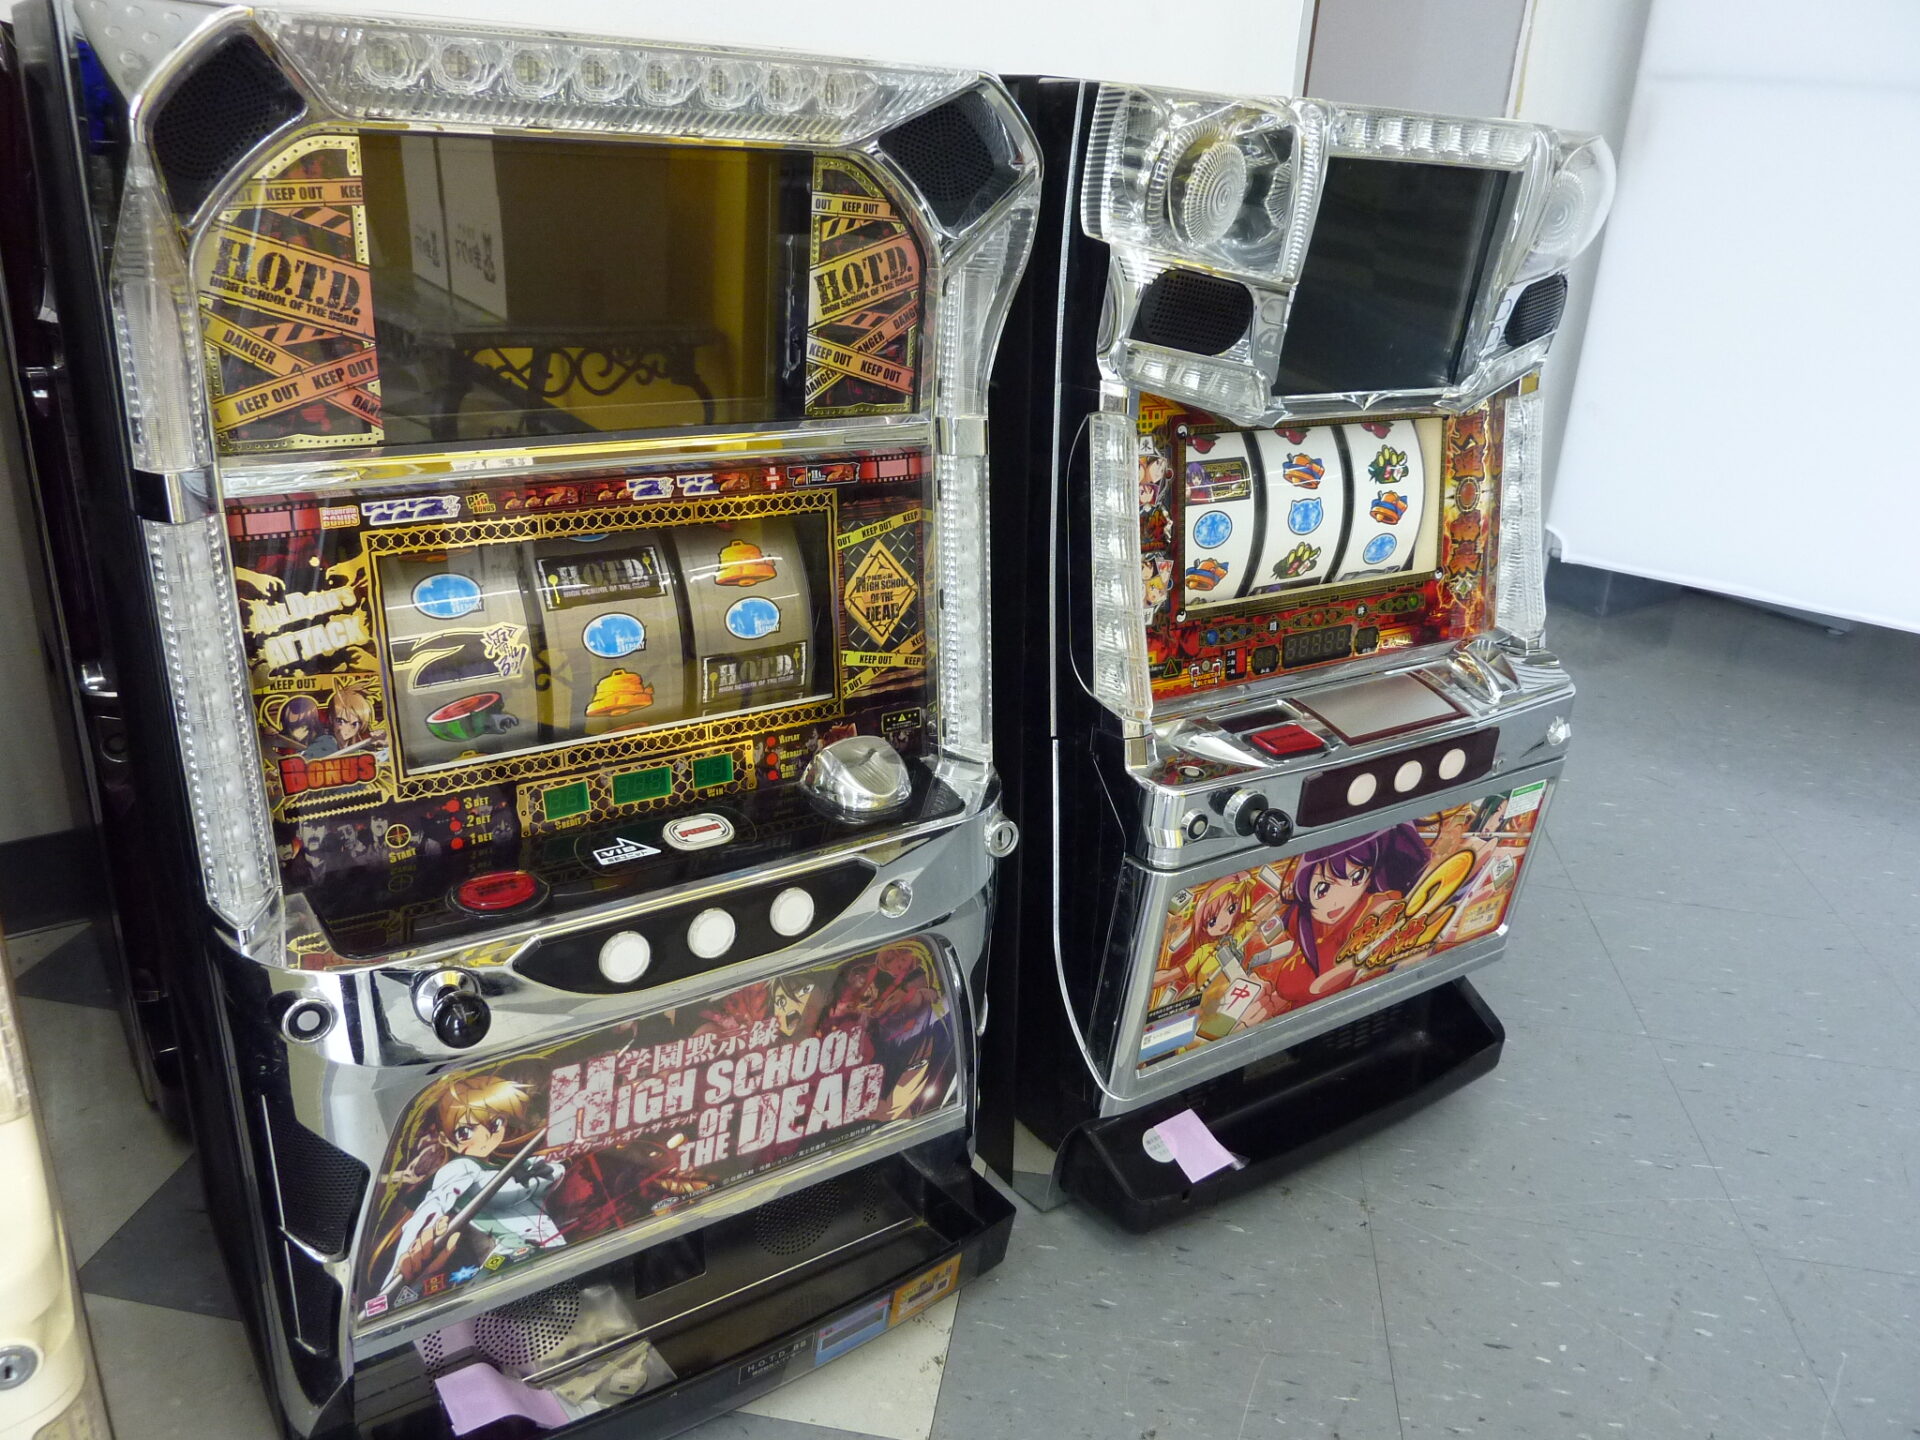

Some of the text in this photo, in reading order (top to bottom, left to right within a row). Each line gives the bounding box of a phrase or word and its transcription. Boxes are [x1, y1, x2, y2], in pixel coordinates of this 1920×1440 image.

[266, 187, 296, 201] KEEP
[299, 186, 324, 200] OUT
[815, 198, 880, 214] OUT KEEP OUT
[209, 276, 243, 296] HIGH
[242, 284, 286, 308] SCHOOL
[289, 298, 304, 311] OF
[306, 303, 327, 318] THE
[222, 329, 277, 365] DANGER
[808, 342, 902, 383] KEEP OUT KEEP OUT
[235, 394, 270, 416] KEEP
[271, 382, 301, 403] OUT
[311, 367, 345, 390] KEEP
[347, 357, 375, 378] OUT
[837, 510, 919, 548] OUT KEEP OUT KEEP
[881, 576, 910, 591] SCHOOL
[880, 591, 894, 602] THE
[865, 602, 900, 623] DEAD
[265, 616, 365, 667] ATTACK
[859, 653, 878, 665] KEEP
[878, 654, 893, 665] OUT
[904, 655, 920, 666] KEEP
[269, 678, 317, 691] KEEP OUT
[848, 677, 863, 691] OUT
[779, 734, 801, 745] REPLAY
[279, 753, 377, 795] BONUS
[706, 787, 725, 798] WIN
[463, 797, 489, 810] 3 BET
[466, 814, 492, 828] 2 BET
[555, 817, 582, 831] CREDIT
[477, 832, 494, 844] BET
[389, 849, 417, 864] START
[1226, 983, 1252, 1012] 中
[617, 1018, 780, 1079] 学園黙示録
[546, 1026, 866, 1149] HIGH SCHOOL
[678, 1063, 885, 1172] THE DEAD
[698, 1105, 733, 1142] OF
